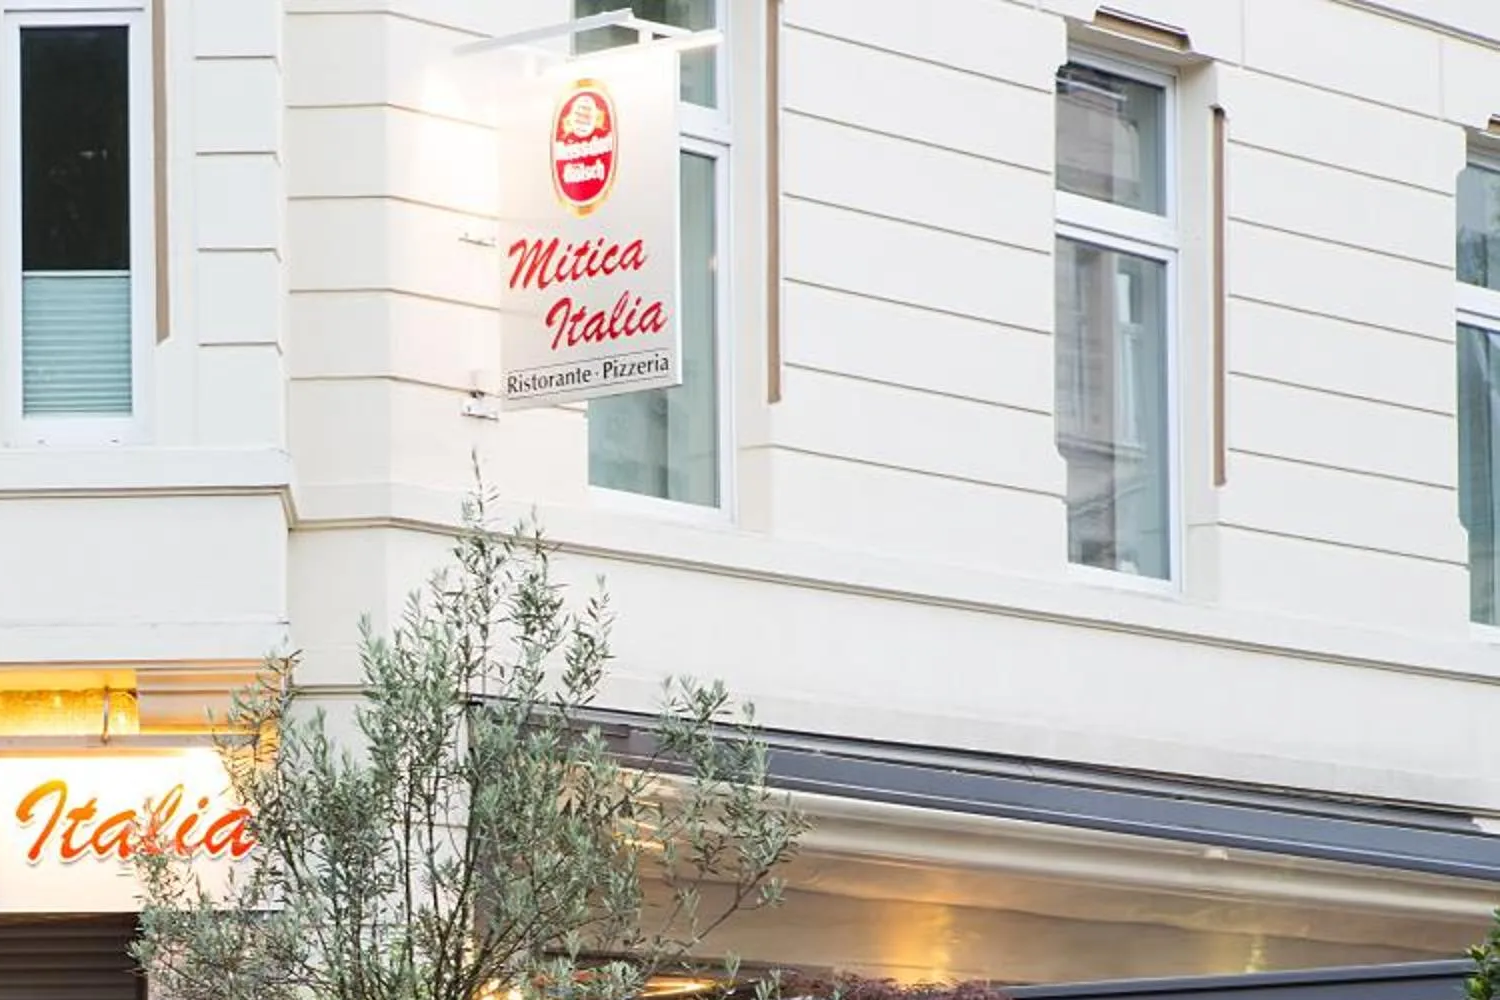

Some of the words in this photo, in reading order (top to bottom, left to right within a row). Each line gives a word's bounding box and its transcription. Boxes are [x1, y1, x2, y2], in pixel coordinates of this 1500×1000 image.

[507, 237, 648, 291] Mitica
[545, 290, 668, 351] Italia
[507, 368, 592, 395] Ristorante
[602, 353, 670, 380] Pizzeria
[15, 779, 257, 860] Italia
